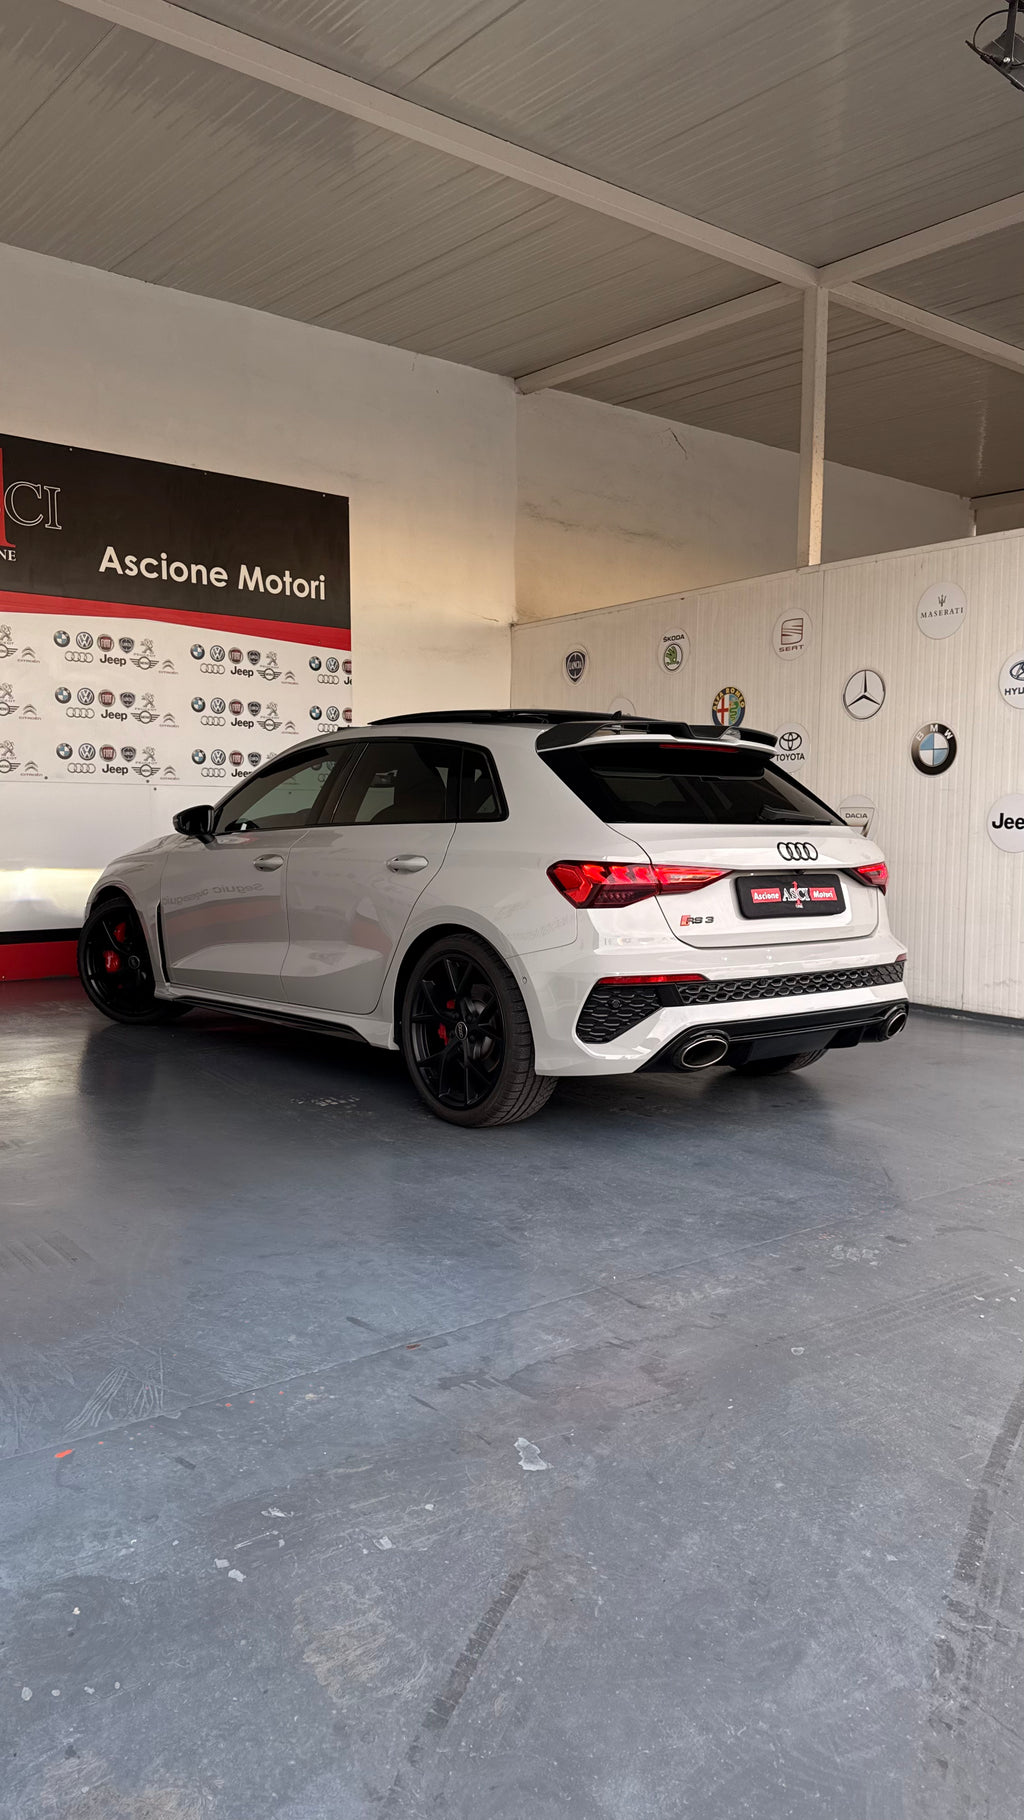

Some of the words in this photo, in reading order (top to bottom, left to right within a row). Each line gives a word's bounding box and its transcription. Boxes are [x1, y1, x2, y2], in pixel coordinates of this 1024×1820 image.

[99, 546, 228, 588] Ascione
[238, 564, 326, 600] Motori
[920, 607, 965, 619] MASERATI
[779, 644, 804, 652] SEAT
[100, 654, 127, 667] Jeep
[230, 666, 254, 678] Jeep
[101, 709, 128, 721] Jeep
[231, 718, 254, 729] Jeep
[916, 724, 954, 741] BMW
[775, 752, 805, 761] TOYOTA
[102, 764, 129, 775] Jeep
[231, 768, 253, 777] Jee
[754, 892, 779, 900] Ascione
[782, 887, 810, 901] ASCI
[684, 916, 703, 925] RS
[705, 916, 714, 924] 3
